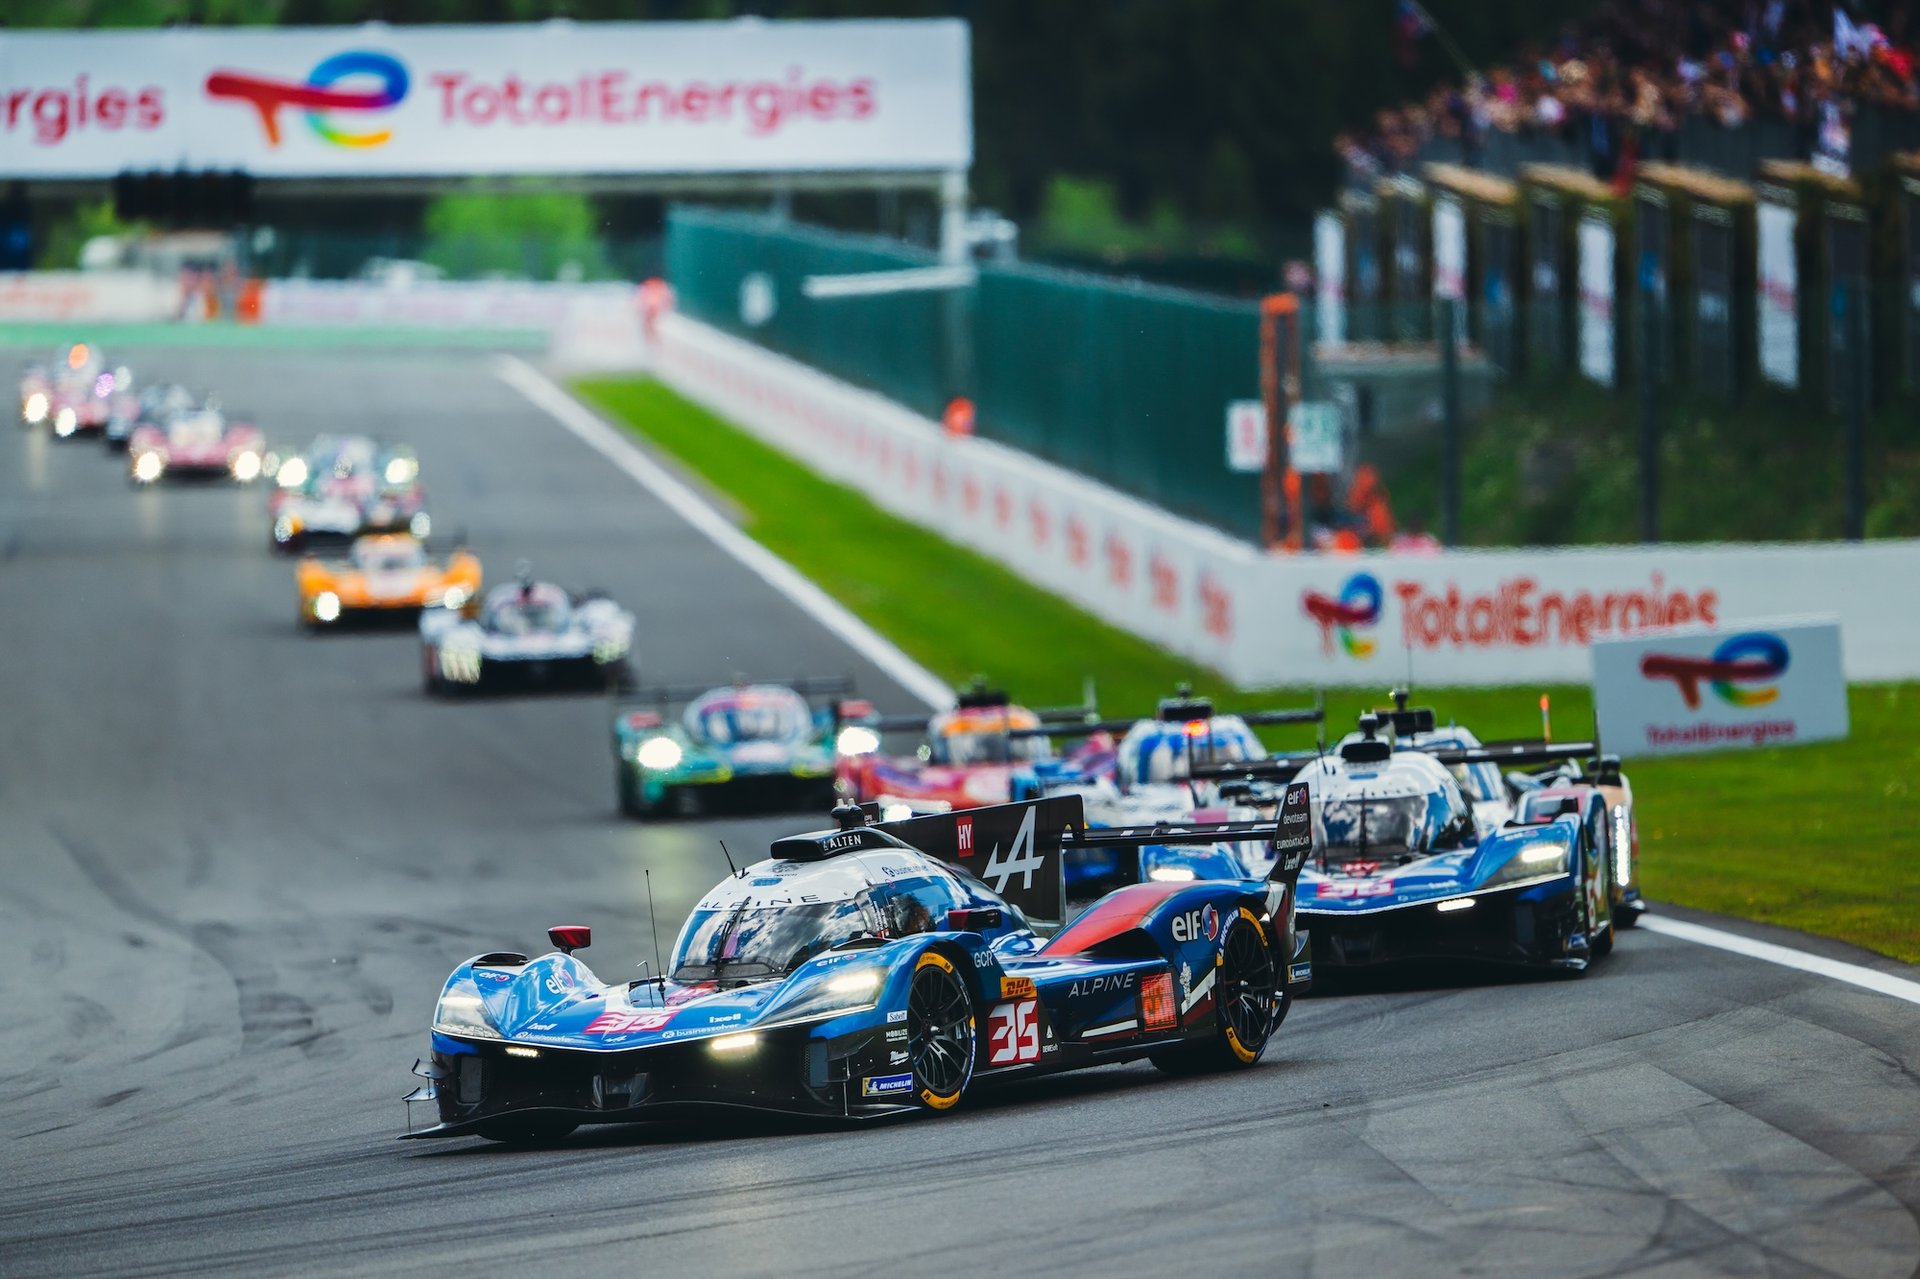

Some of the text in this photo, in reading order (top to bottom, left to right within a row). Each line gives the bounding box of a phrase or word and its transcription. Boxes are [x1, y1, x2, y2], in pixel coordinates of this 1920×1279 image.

[430, 64, 878, 137] TotalEnergies
[1287, 789, 1300, 806] elf
[1283, 811, 1308, 825] devoteam
[829, 834, 862, 849] ALTEN
[957, 823, 972, 850] HY
[1276, 835, 1310, 850] EURODATACAR
[700, 894, 821, 909] ALPINE
[1171, 910, 1201, 942] elf
[973, 950, 994, 968] GCR
[545, 972, 565, 995] elf
[1005, 978, 1033, 995] DHL
[1067, 972, 1136, 998] ALPINE
[676, 1023, 740, 1037] businessolver
[988, 1000, 1040, 1063] 35
[879, 1079, 913, 1090] MICHELIN
